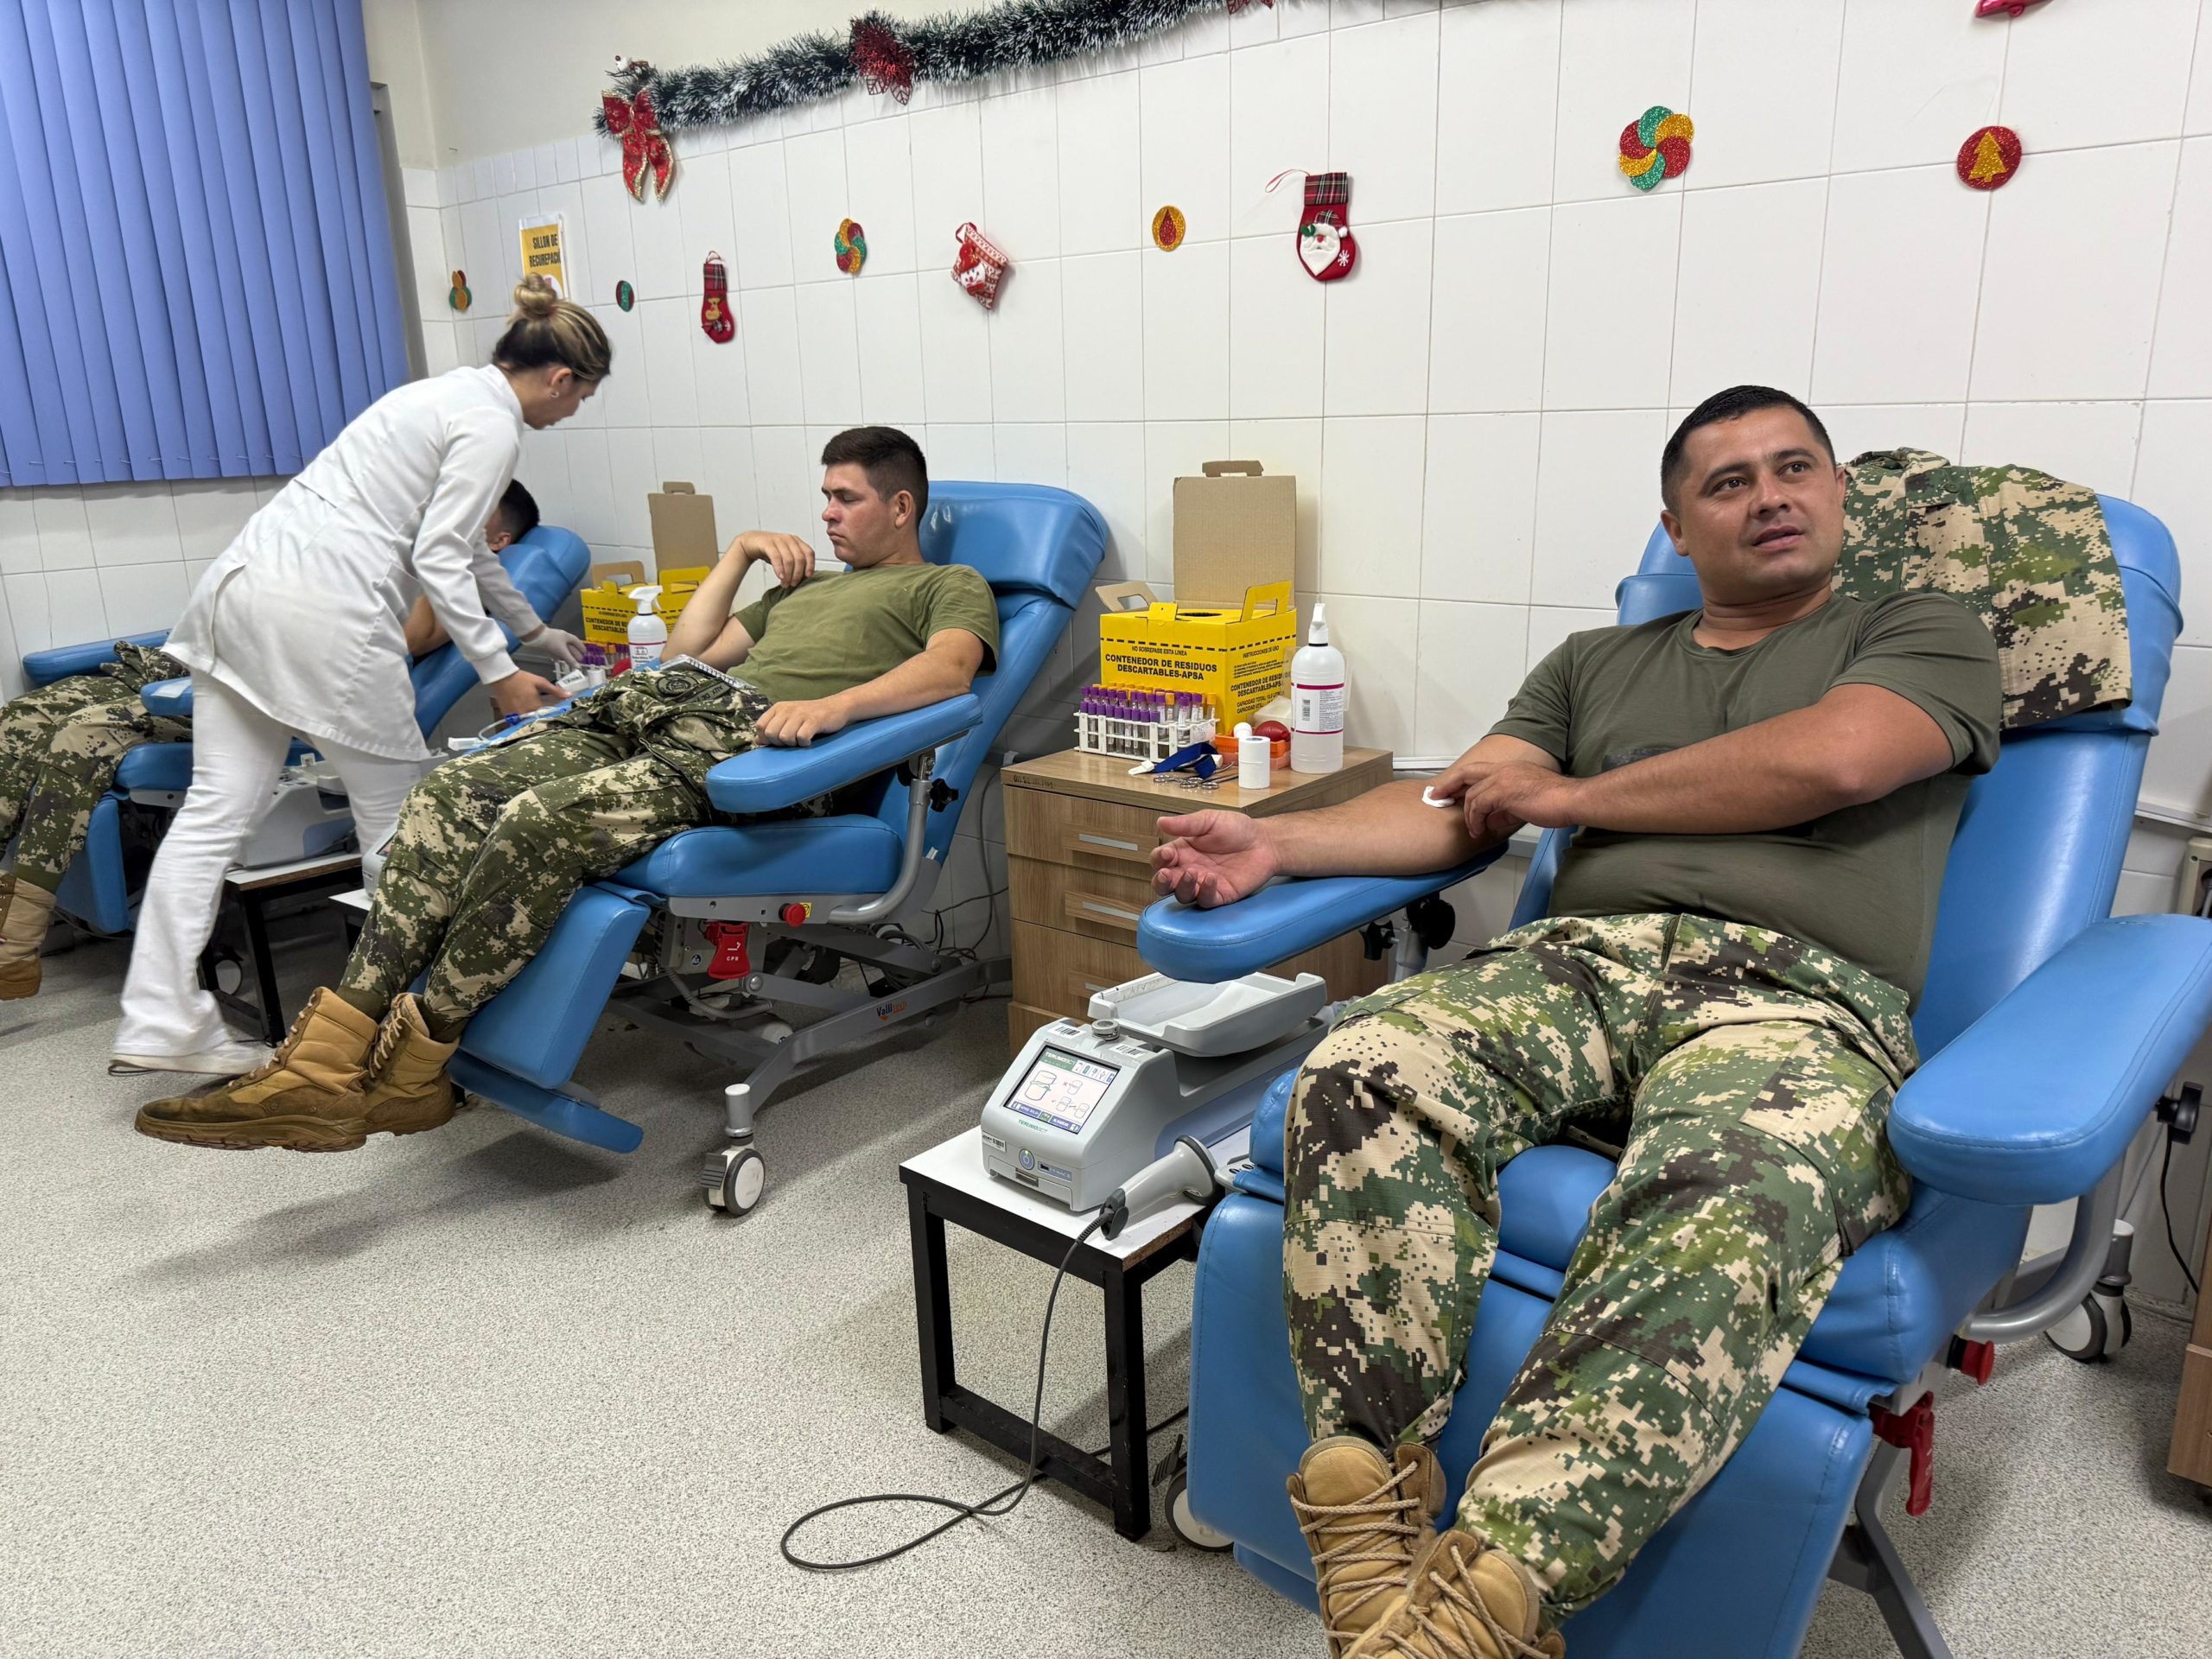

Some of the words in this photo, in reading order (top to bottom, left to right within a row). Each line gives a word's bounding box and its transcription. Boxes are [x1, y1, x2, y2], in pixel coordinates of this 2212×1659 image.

[550, 234, 558, 246] DE
[1105, 654, 1159, 667] CONTENEDOR
[1161, 659, 1173, 668] DE
[1175, 661, 1217, 672] RESIDUOS
[1117, 664, 1205, 681] DESCARTABLES-APSA
[712, 684, 723, 695] AUX
[1230, 678, 1262, 692] CONTENEDOR
[1237, 698, 1255, 708] CAPACIDAD
[1237, 704, 1255, 714] CAPACIDAD
